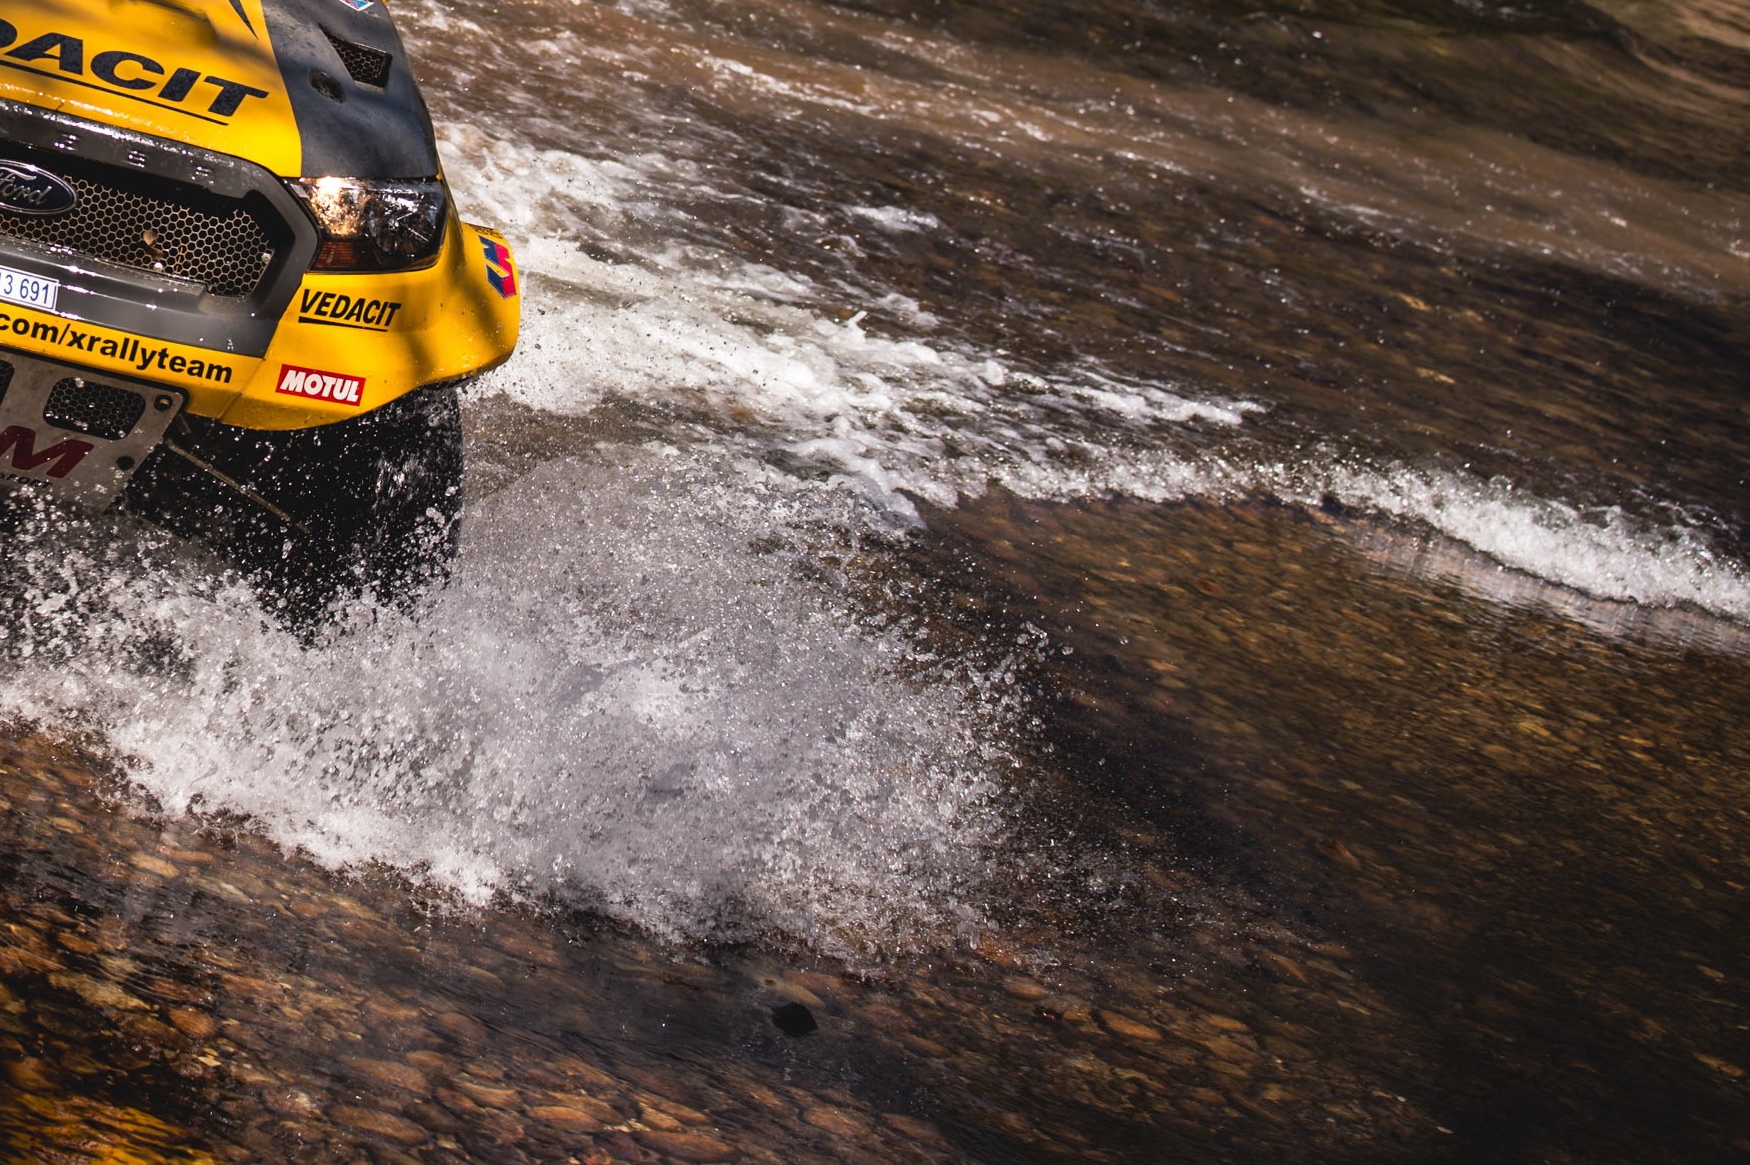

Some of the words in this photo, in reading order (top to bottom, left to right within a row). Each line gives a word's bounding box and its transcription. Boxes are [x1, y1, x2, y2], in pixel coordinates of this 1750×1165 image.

[19, 277, 49, 305] 691
[299, 288, 402, 327] VEDACIT
[279, 369, 360, 402] MOTUL
